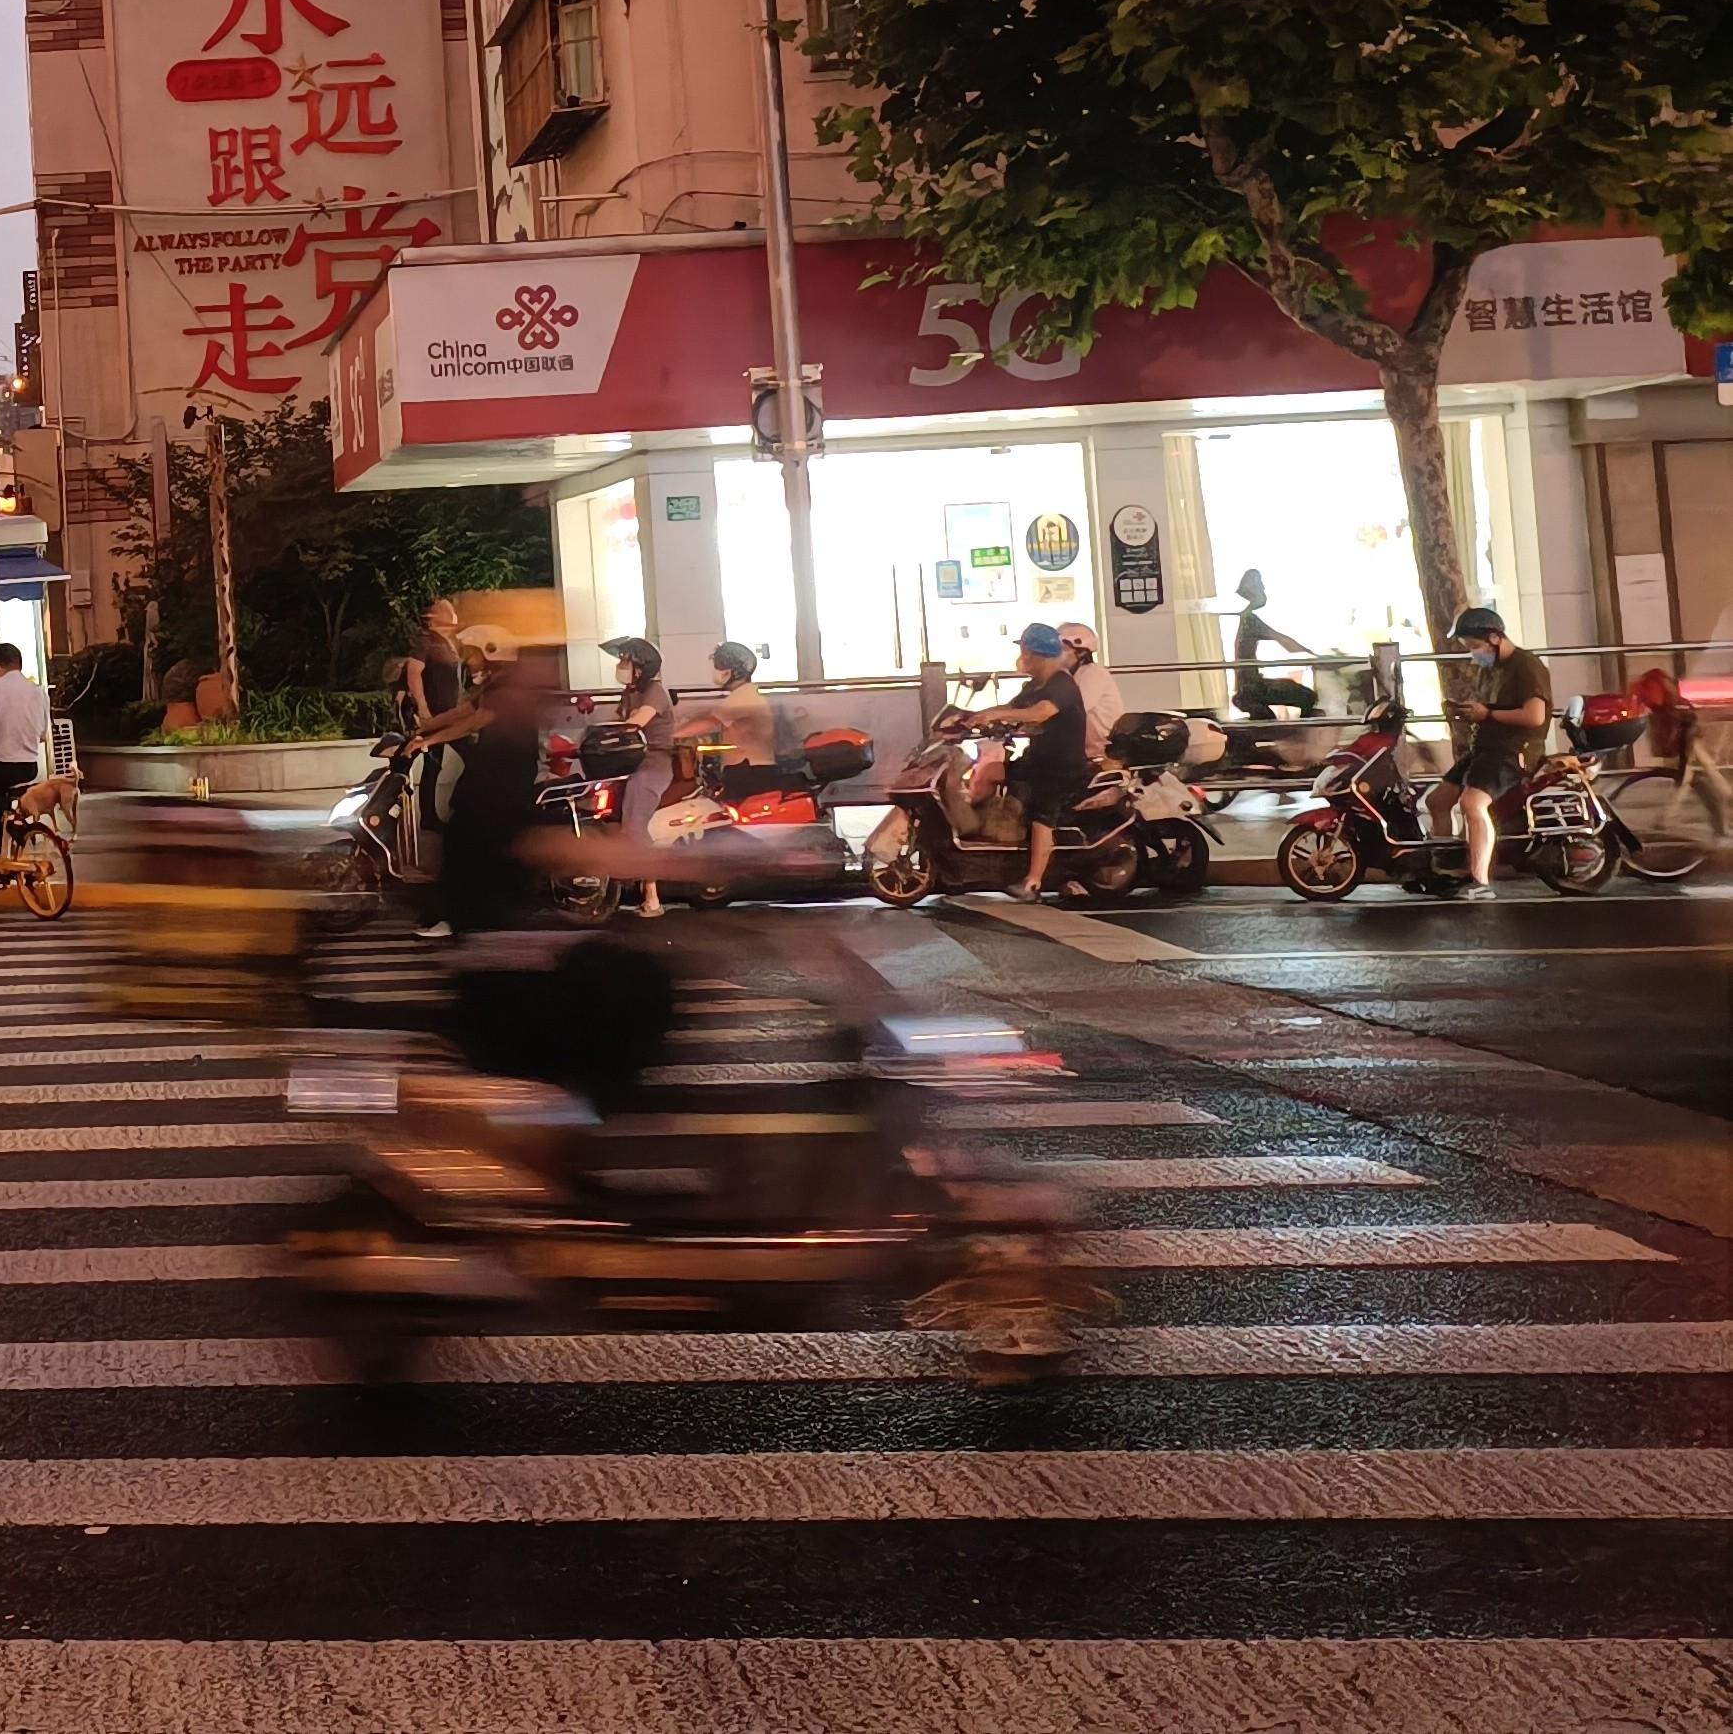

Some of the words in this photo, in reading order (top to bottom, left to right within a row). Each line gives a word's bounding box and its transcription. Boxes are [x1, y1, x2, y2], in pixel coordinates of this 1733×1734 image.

[133, 231, 211, 253] ALWAYS
[211, 227, 291, 248] FOLLOW
[174, 256, 214, 276] THE
[217, 252, 283, 274] PARTY
[1465, 288, 1654, 333] 智慧生活馆
[908, 280, 1085, 387] 5G
[427, 339, 488, 361] China
[430, 360, 506, 378] unicom
[506, 354, 575, 374] 中国联通
